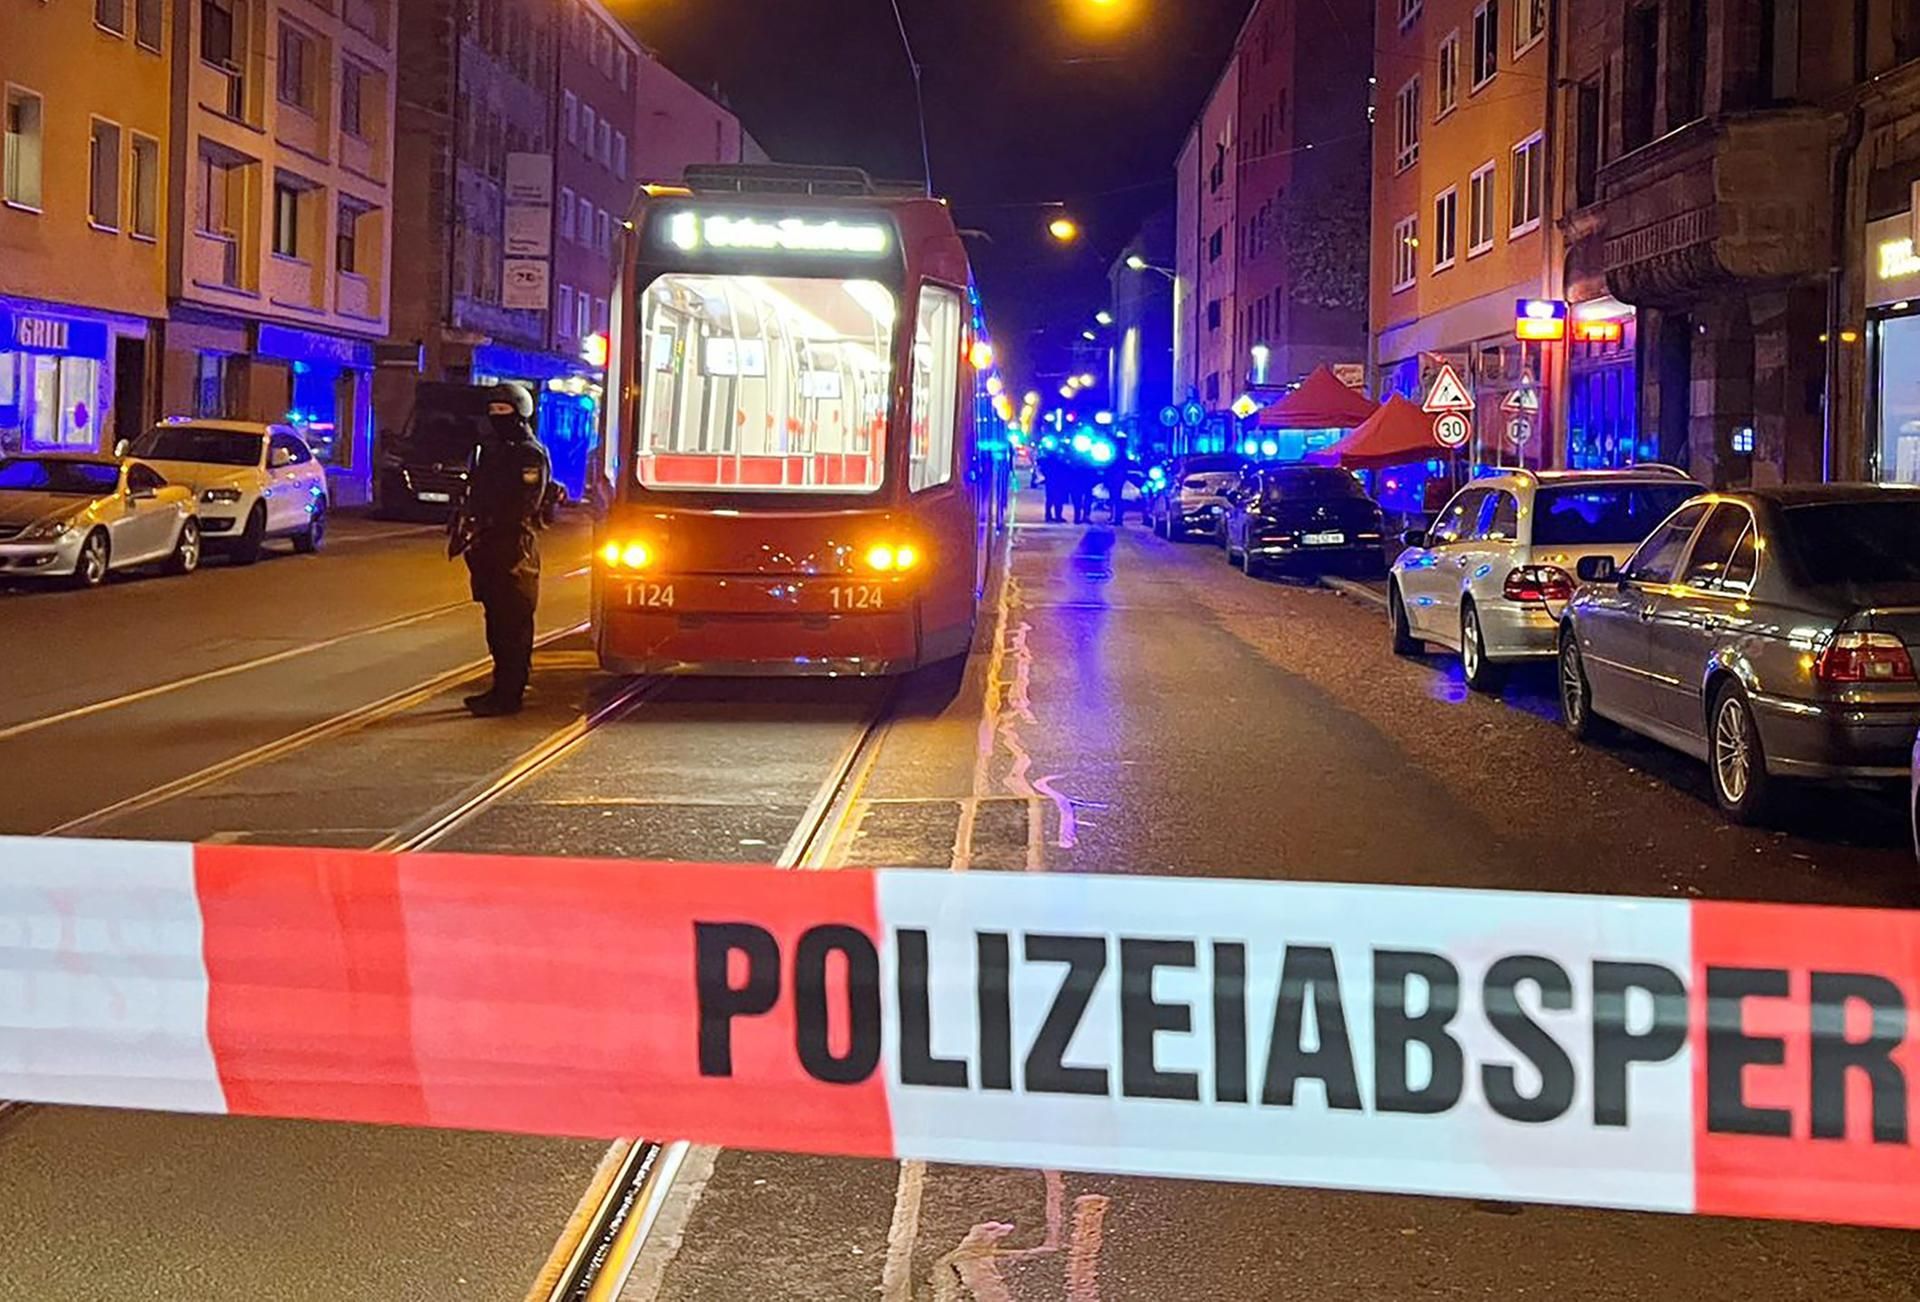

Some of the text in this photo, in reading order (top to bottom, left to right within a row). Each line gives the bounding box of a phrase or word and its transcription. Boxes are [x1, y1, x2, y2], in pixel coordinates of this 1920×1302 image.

[1441, 420, 1463, 438] 30
[624, 583, 675, 608] 1124
[830, 586, 884, 609] 1124
[693, 919, 1908, 1144] POLIZEIABSPER
